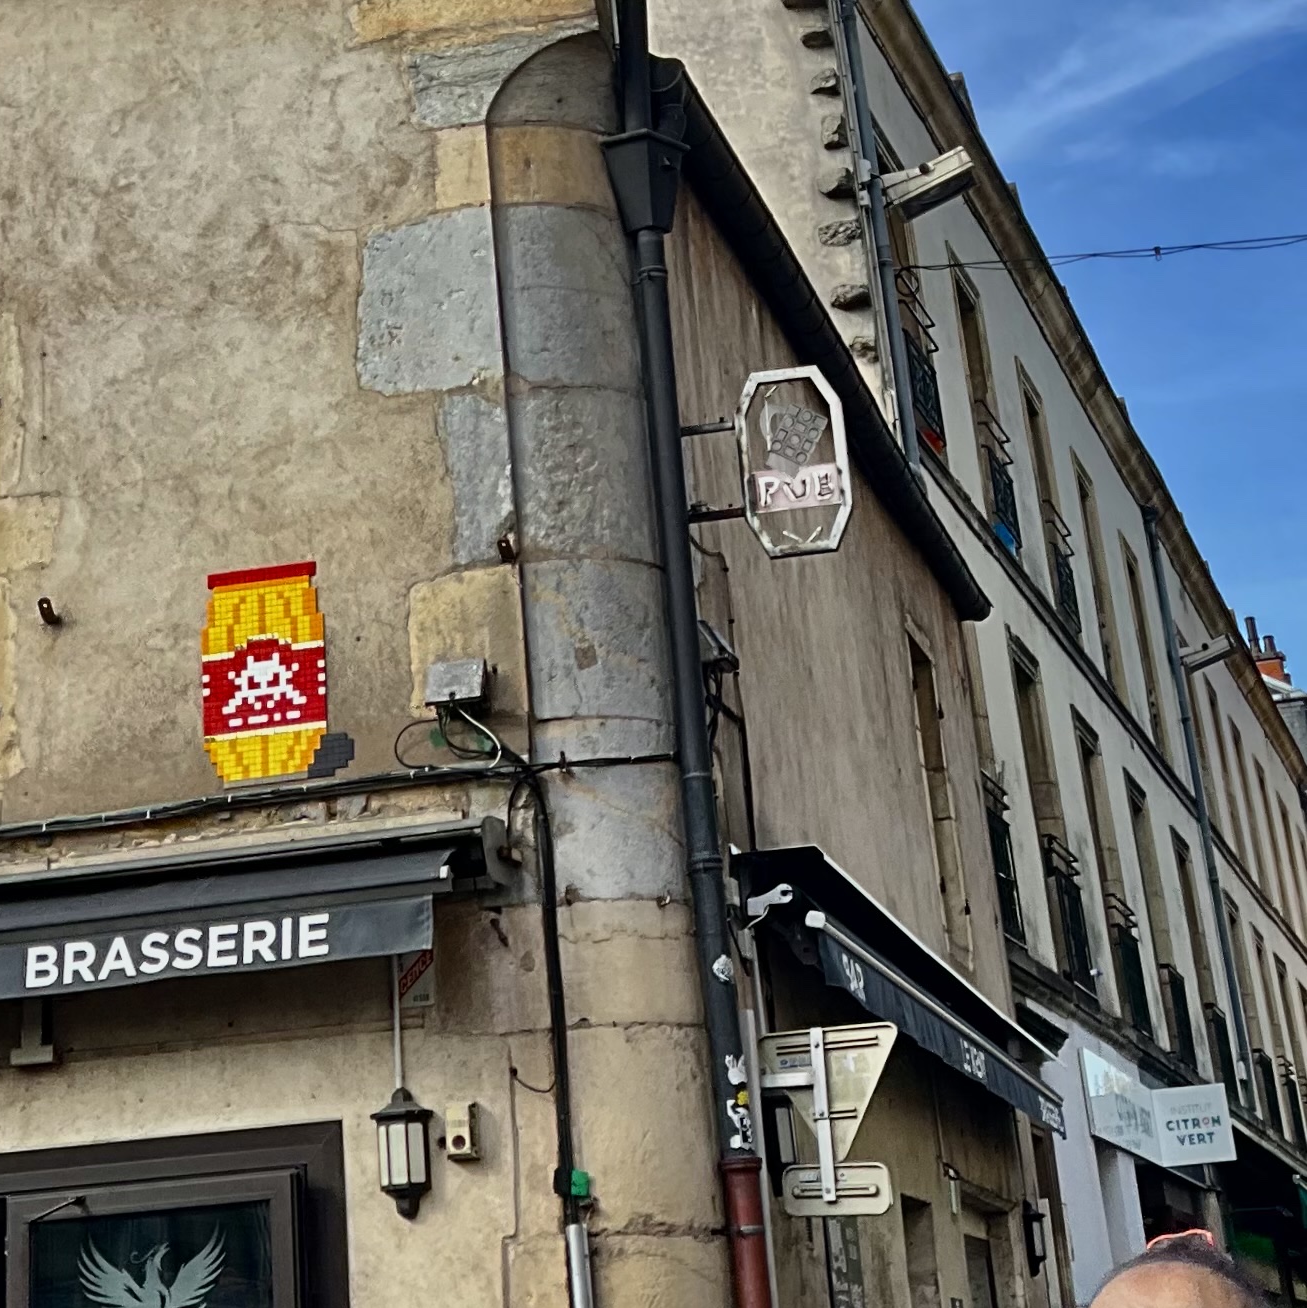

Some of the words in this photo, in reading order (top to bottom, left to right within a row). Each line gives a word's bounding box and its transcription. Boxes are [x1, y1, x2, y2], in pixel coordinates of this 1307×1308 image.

[25, 913, 330, 988] BRASSERIE
[1170, 1102, 1212, 1116] INSTITUT
[1166, 1115, 1221, 1132] CITRON
[1176, 1131, 1215, 1146] VERT
